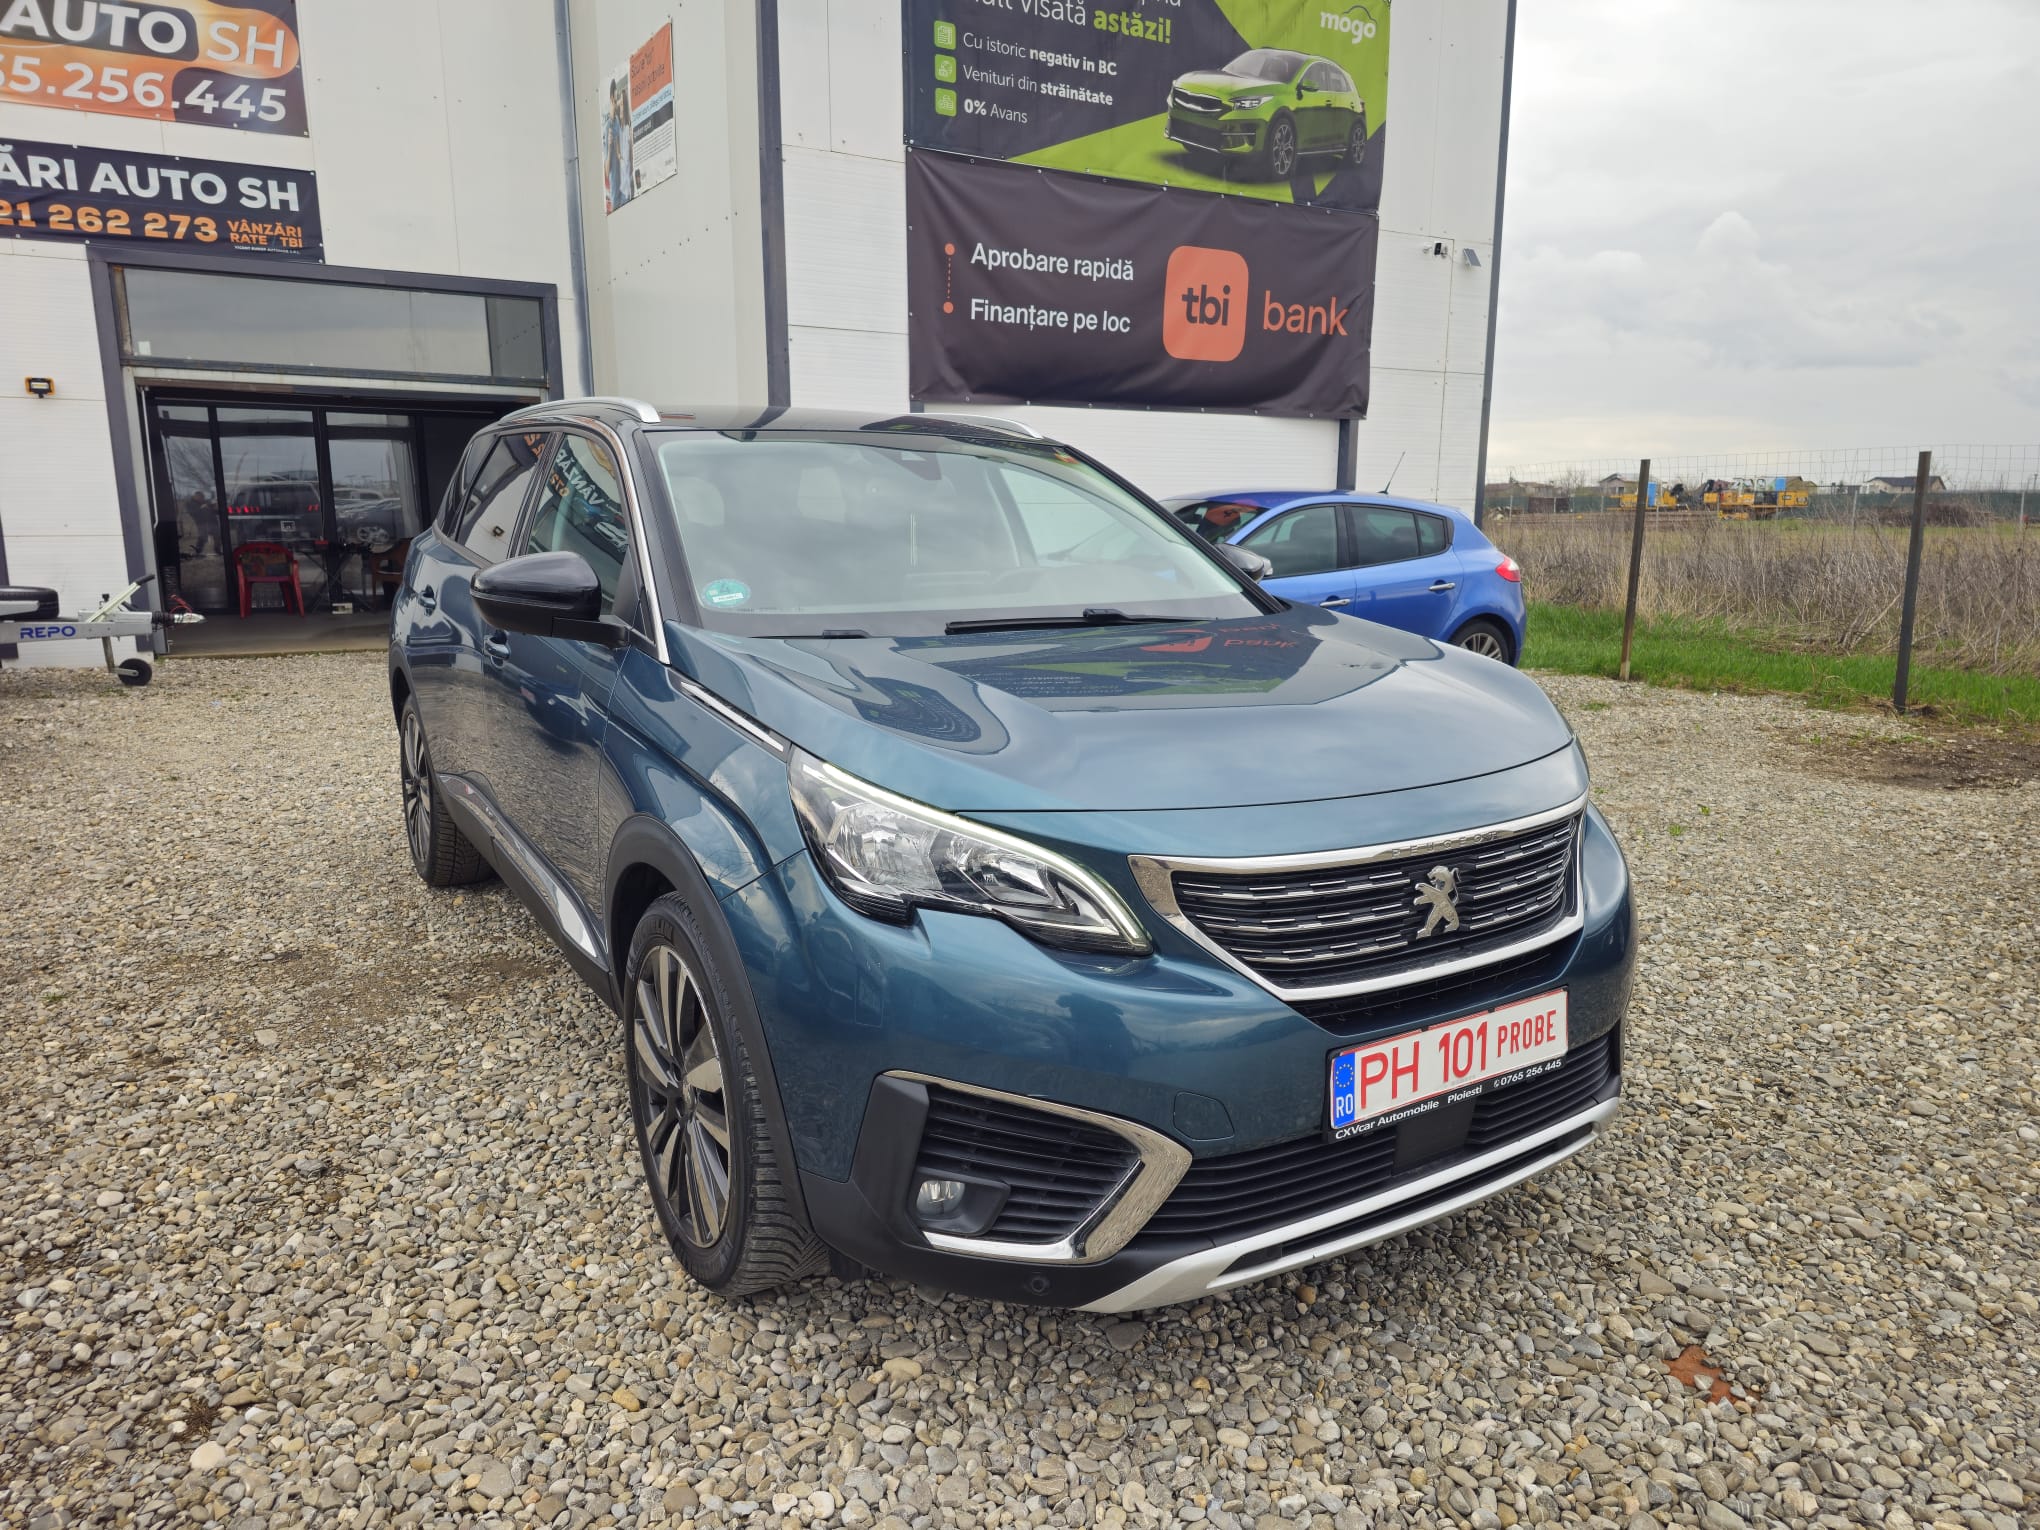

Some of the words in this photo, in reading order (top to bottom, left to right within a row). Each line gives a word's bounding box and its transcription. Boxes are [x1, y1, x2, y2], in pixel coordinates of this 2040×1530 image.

[0, 0, 187, 53] AUTO
[206, 20, 285, 68] SH
[1093, 9, 1171, 44] astăzi!
[1320, 11, 1376, 44] mogo
[963, 32, 983, 49] Cu
[986, 36, 1027, 58] istoric
[1029, 48, 1080, 67] negativ
[1082, 56, 1095, 72] in
[1098, 60, 1118, 76] BC
[0, 54, 287, 122] 5.256.445
[963, 65, 1014, 88] Venituri
[1017, 75, 1037, 92] din
[1040, 81, 1113, 106] străinătate
[964, 98, 987, 116] 0%
[990, 103, 1028, 124] Avans
[89, 162, 227, 204] AUTO
[238, 177, 300, 212] SH
[48, 204, 132, 235] 262
[143, 212, 218, 242] 273
[227, 218, 302, 237] VÂNZĂRI
[230, 232, 268, 246] RATE
[280, 236, 303, 249] TBI
[970, 242, 1069, 274] Aprobare
[1073, 257, 1134, 282] rapidă
[970, 298, 1069, 331] Finanțare
[1073, 312, 1098, 333] pe
[1102, 310, 1131, 333] loc
[1181, 285, 1231, 326] tbi
[1263, 290, 1348, 336] bank
[20, 626, 76, 639] REPO
[1361, 1041, 1419, 1110] PH
[1438, 1021, 1488, 1083] 101
[1497, 1009, 1557, 1058] PROBE
[1335, 1121, 1376, 1140] CXVcar
[1377, 1100, 1439, 1127] Automobile
[1447, 1085, 1482, 1103] Ploiesti
[1500, 1071, 1524, 1086] 0765
[1525, 1065, 1543, 1078] 256
[1544, 1059, 1562, 1071] 445
[1335, 1093, 1354, 1118] RO
